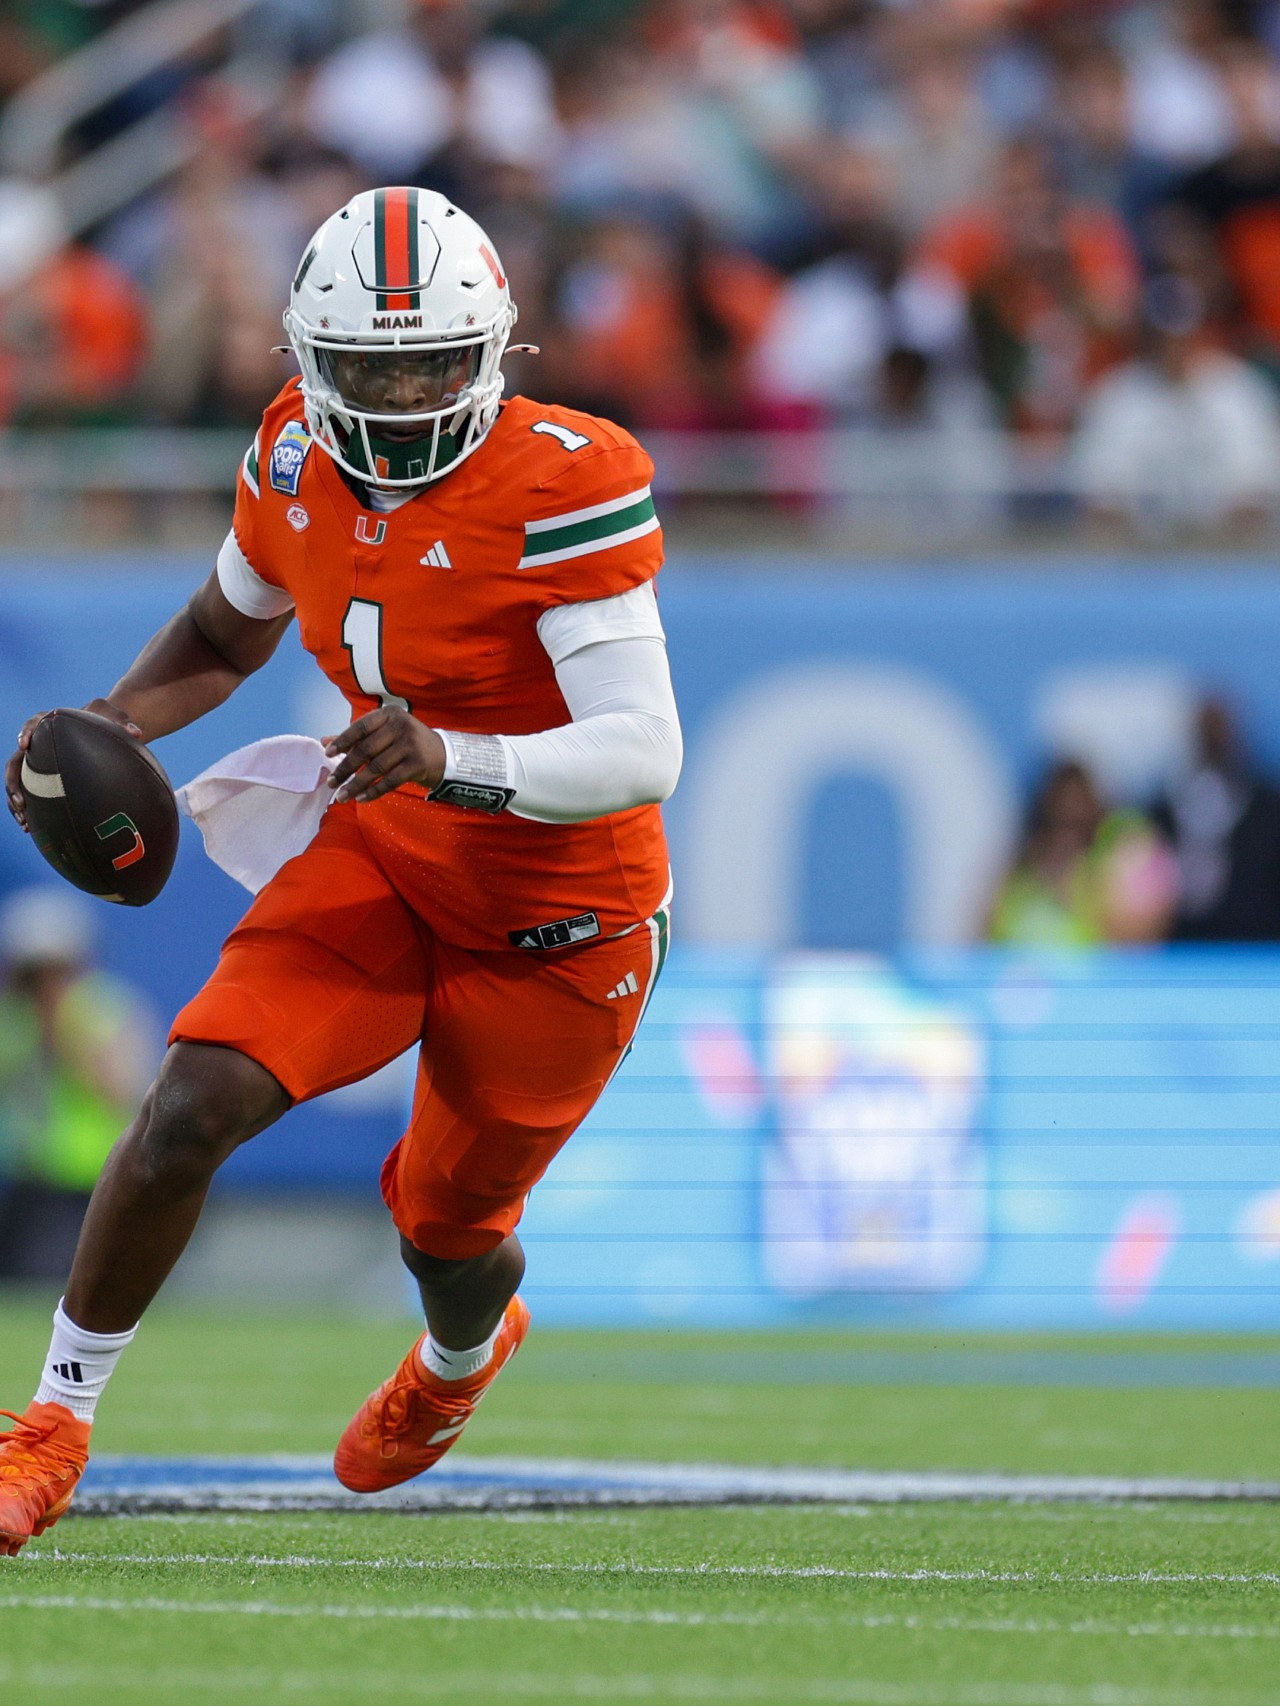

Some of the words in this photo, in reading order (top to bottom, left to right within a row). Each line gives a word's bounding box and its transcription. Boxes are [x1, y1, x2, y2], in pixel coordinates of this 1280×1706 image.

[373, 315, 422, 330] MIAMI
[531, 420, 592, 453] 1
[290, 510, 307, 522] ACC
[354, 515, 388, 545] U
[341, 596, 413, 714] 1
[94, 812, 145, 871] U
